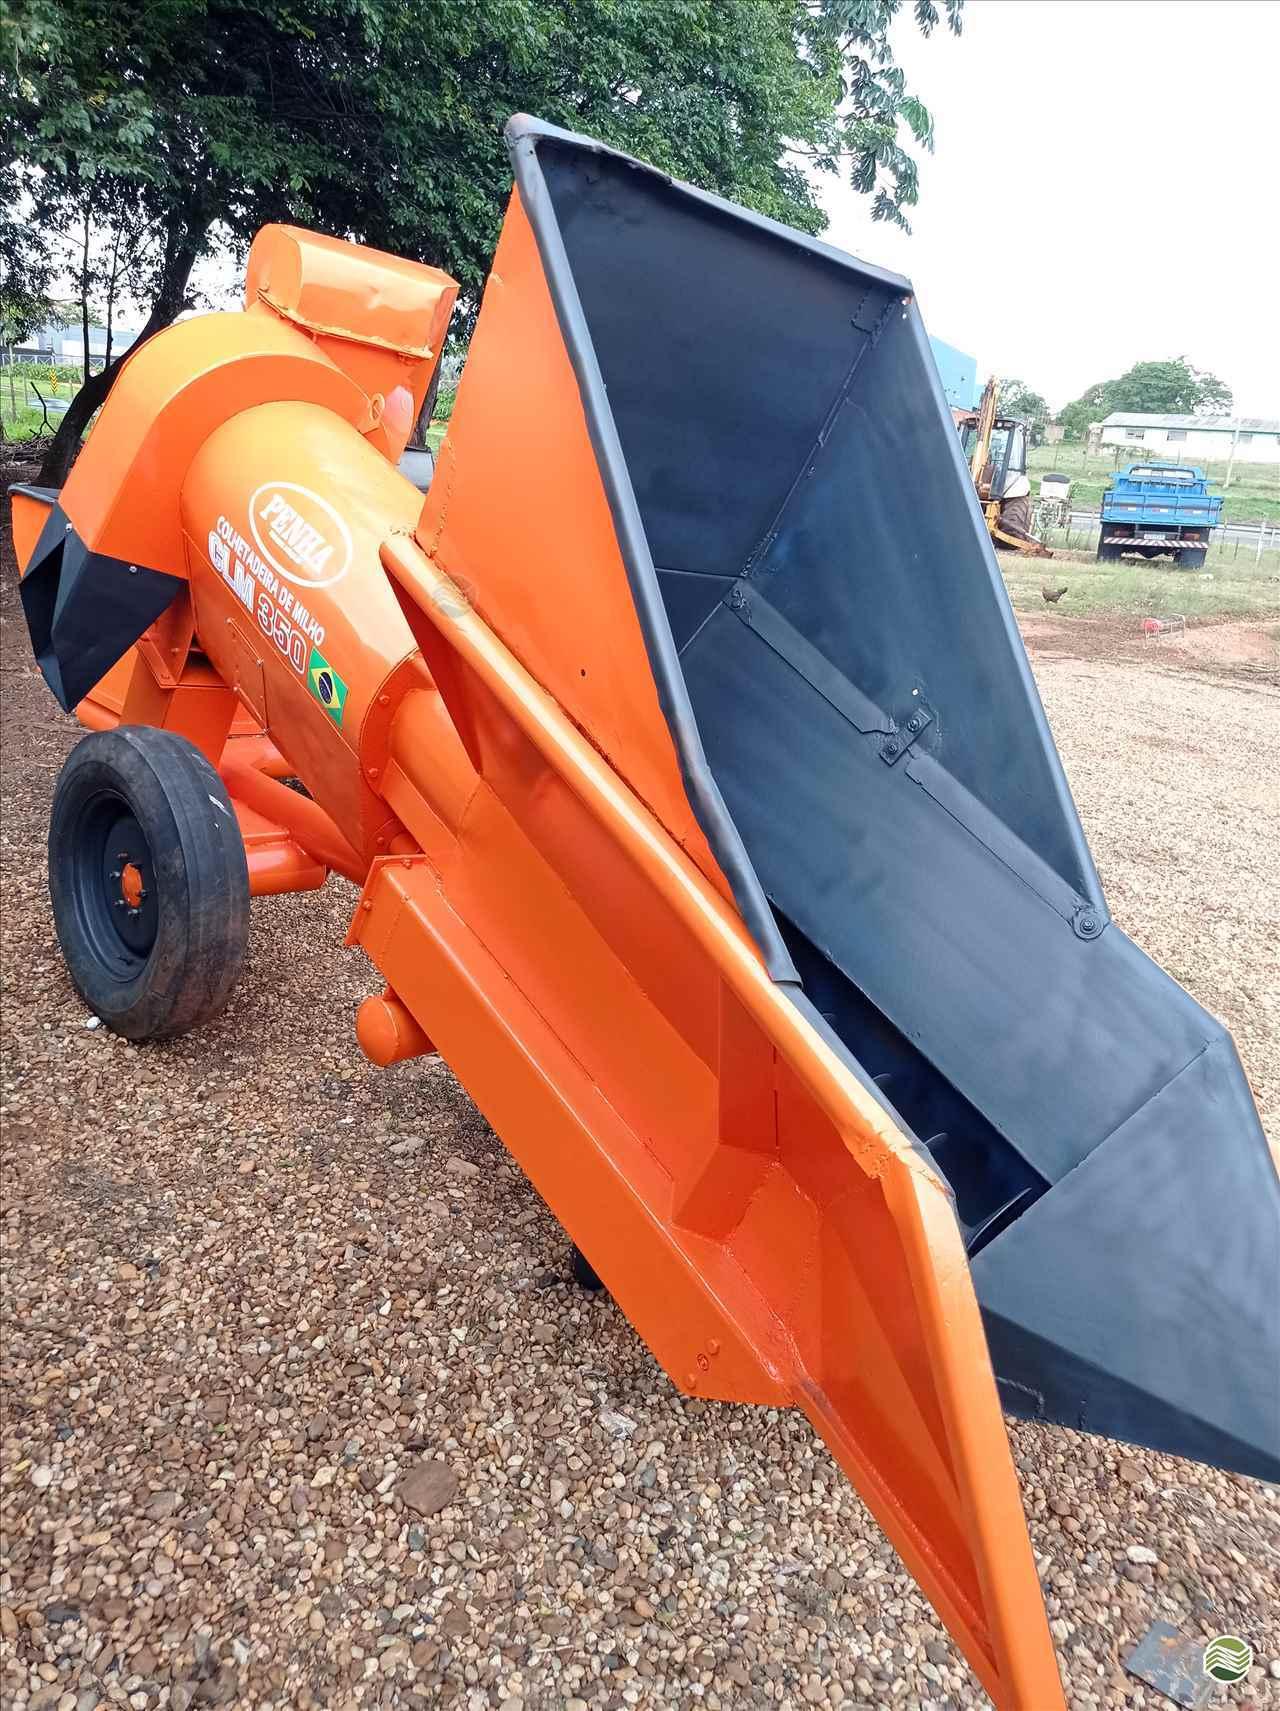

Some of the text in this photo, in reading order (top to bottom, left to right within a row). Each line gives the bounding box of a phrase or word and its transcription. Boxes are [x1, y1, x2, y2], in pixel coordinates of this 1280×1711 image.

[259, 494, 335, 574] PENHA
[216, 515, 326, 646] COLHETADEIRA DE MILHO
[257, 593, 307, 674] 350
